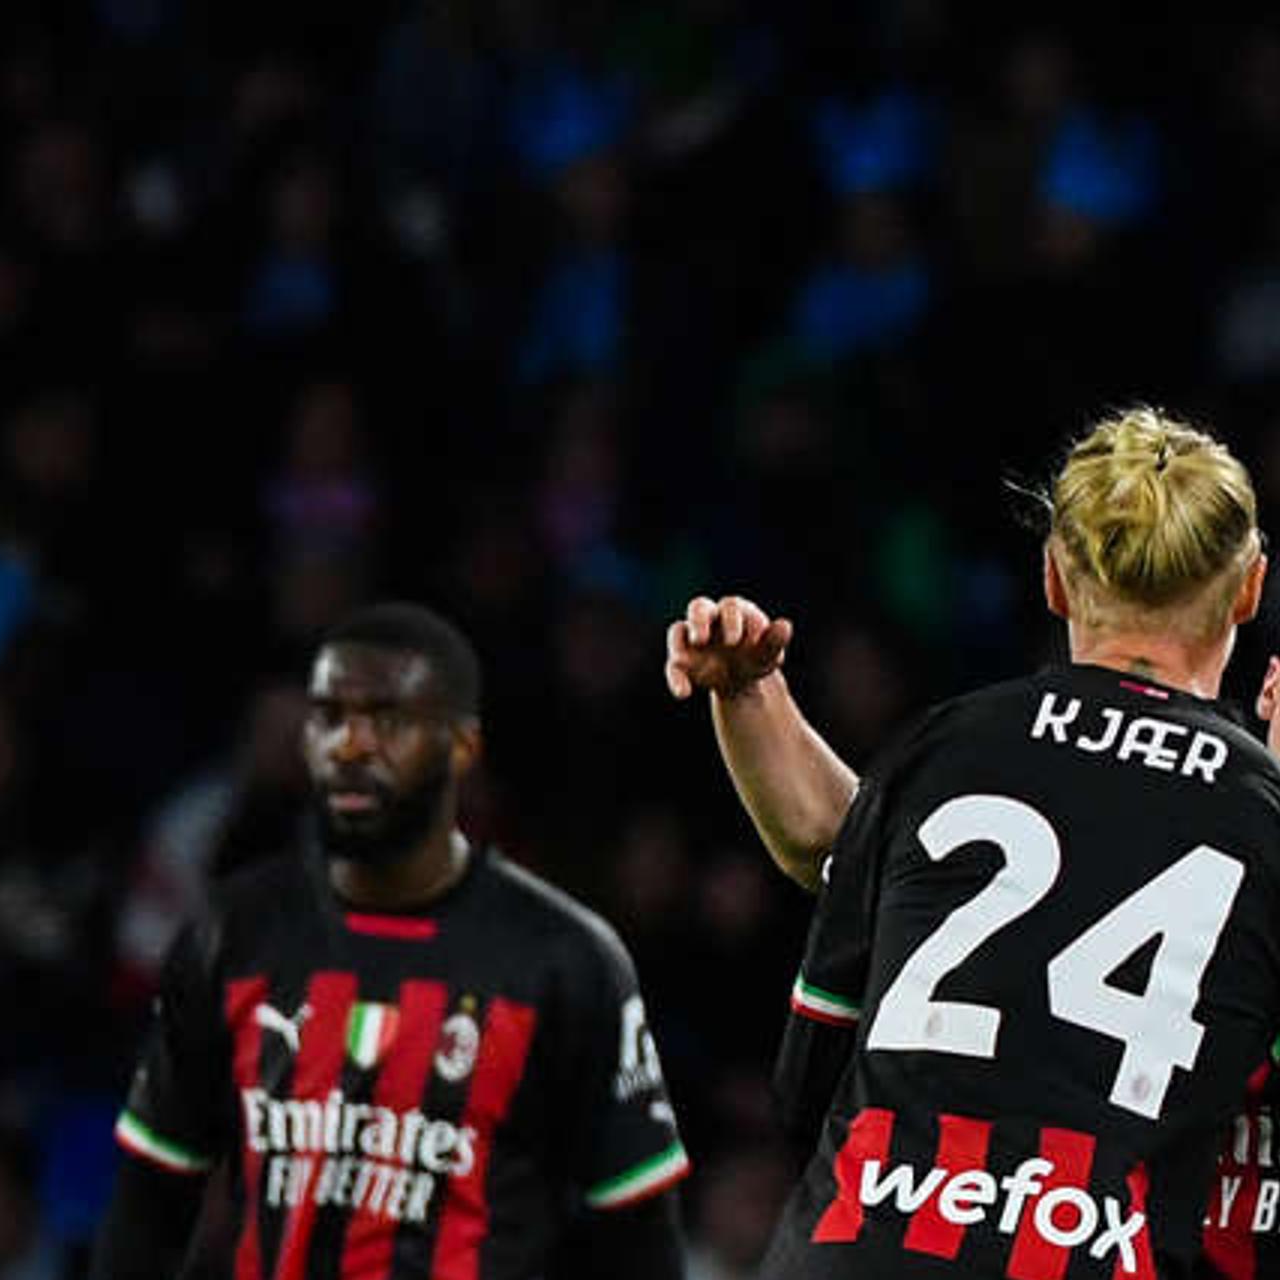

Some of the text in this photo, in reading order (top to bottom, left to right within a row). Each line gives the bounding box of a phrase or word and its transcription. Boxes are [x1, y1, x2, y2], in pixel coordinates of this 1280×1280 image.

[1031, 692, 1228, 783] KJÆR
[866, 794, 1246, 1121] 24
[240, 1086, 478, 1177] Emirates
[858, 1157, 1147, 1275] wefox
